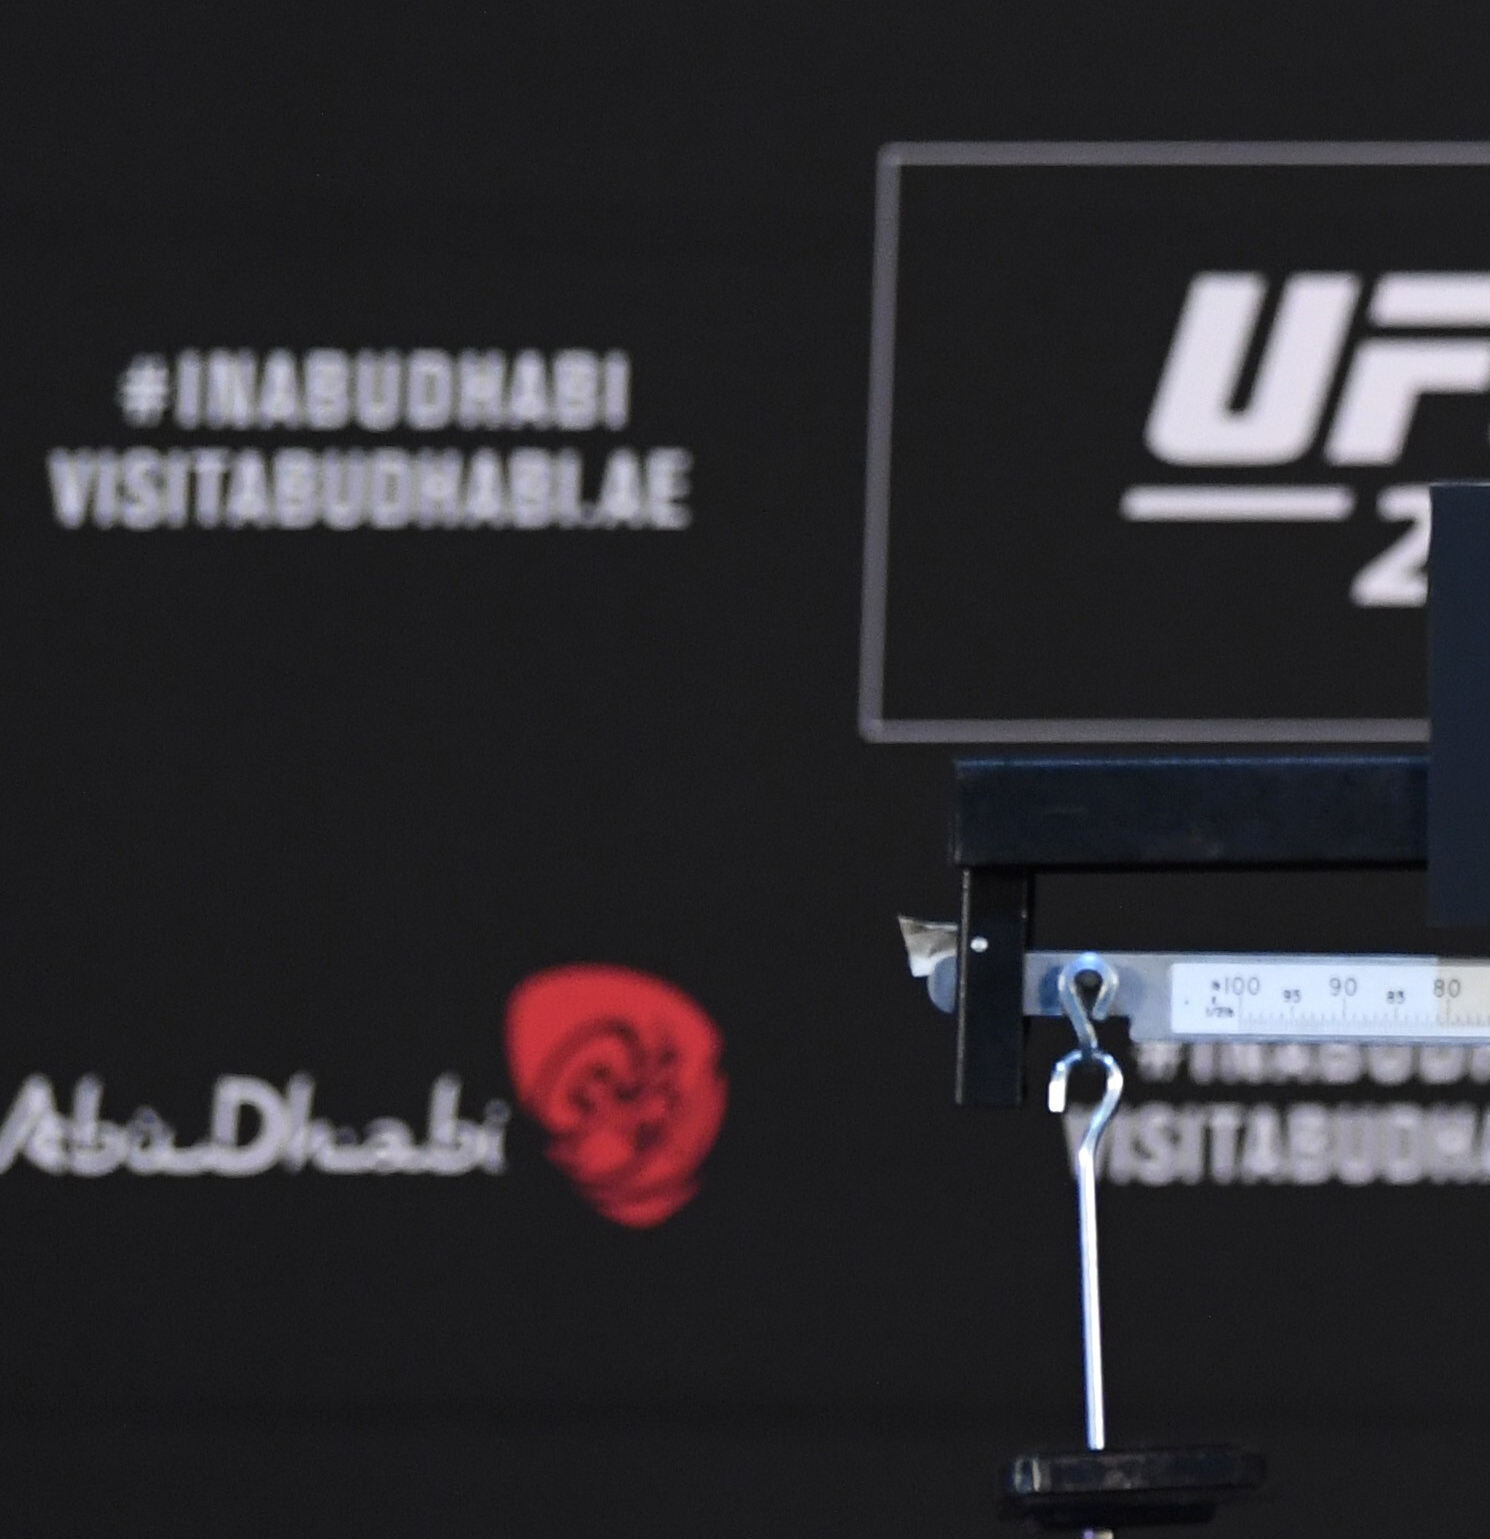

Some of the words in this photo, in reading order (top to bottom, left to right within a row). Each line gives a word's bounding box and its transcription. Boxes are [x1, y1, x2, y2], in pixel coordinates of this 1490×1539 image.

[118, 348, 630, 430] #INABUDHABI
[48, 447, 691, 530] VISITABUDHABI.AE
[1224, 975, 1261, 997] 100
[1329, 977, 1358, 997] 90
[1434, 976, 1463, 999] 80
